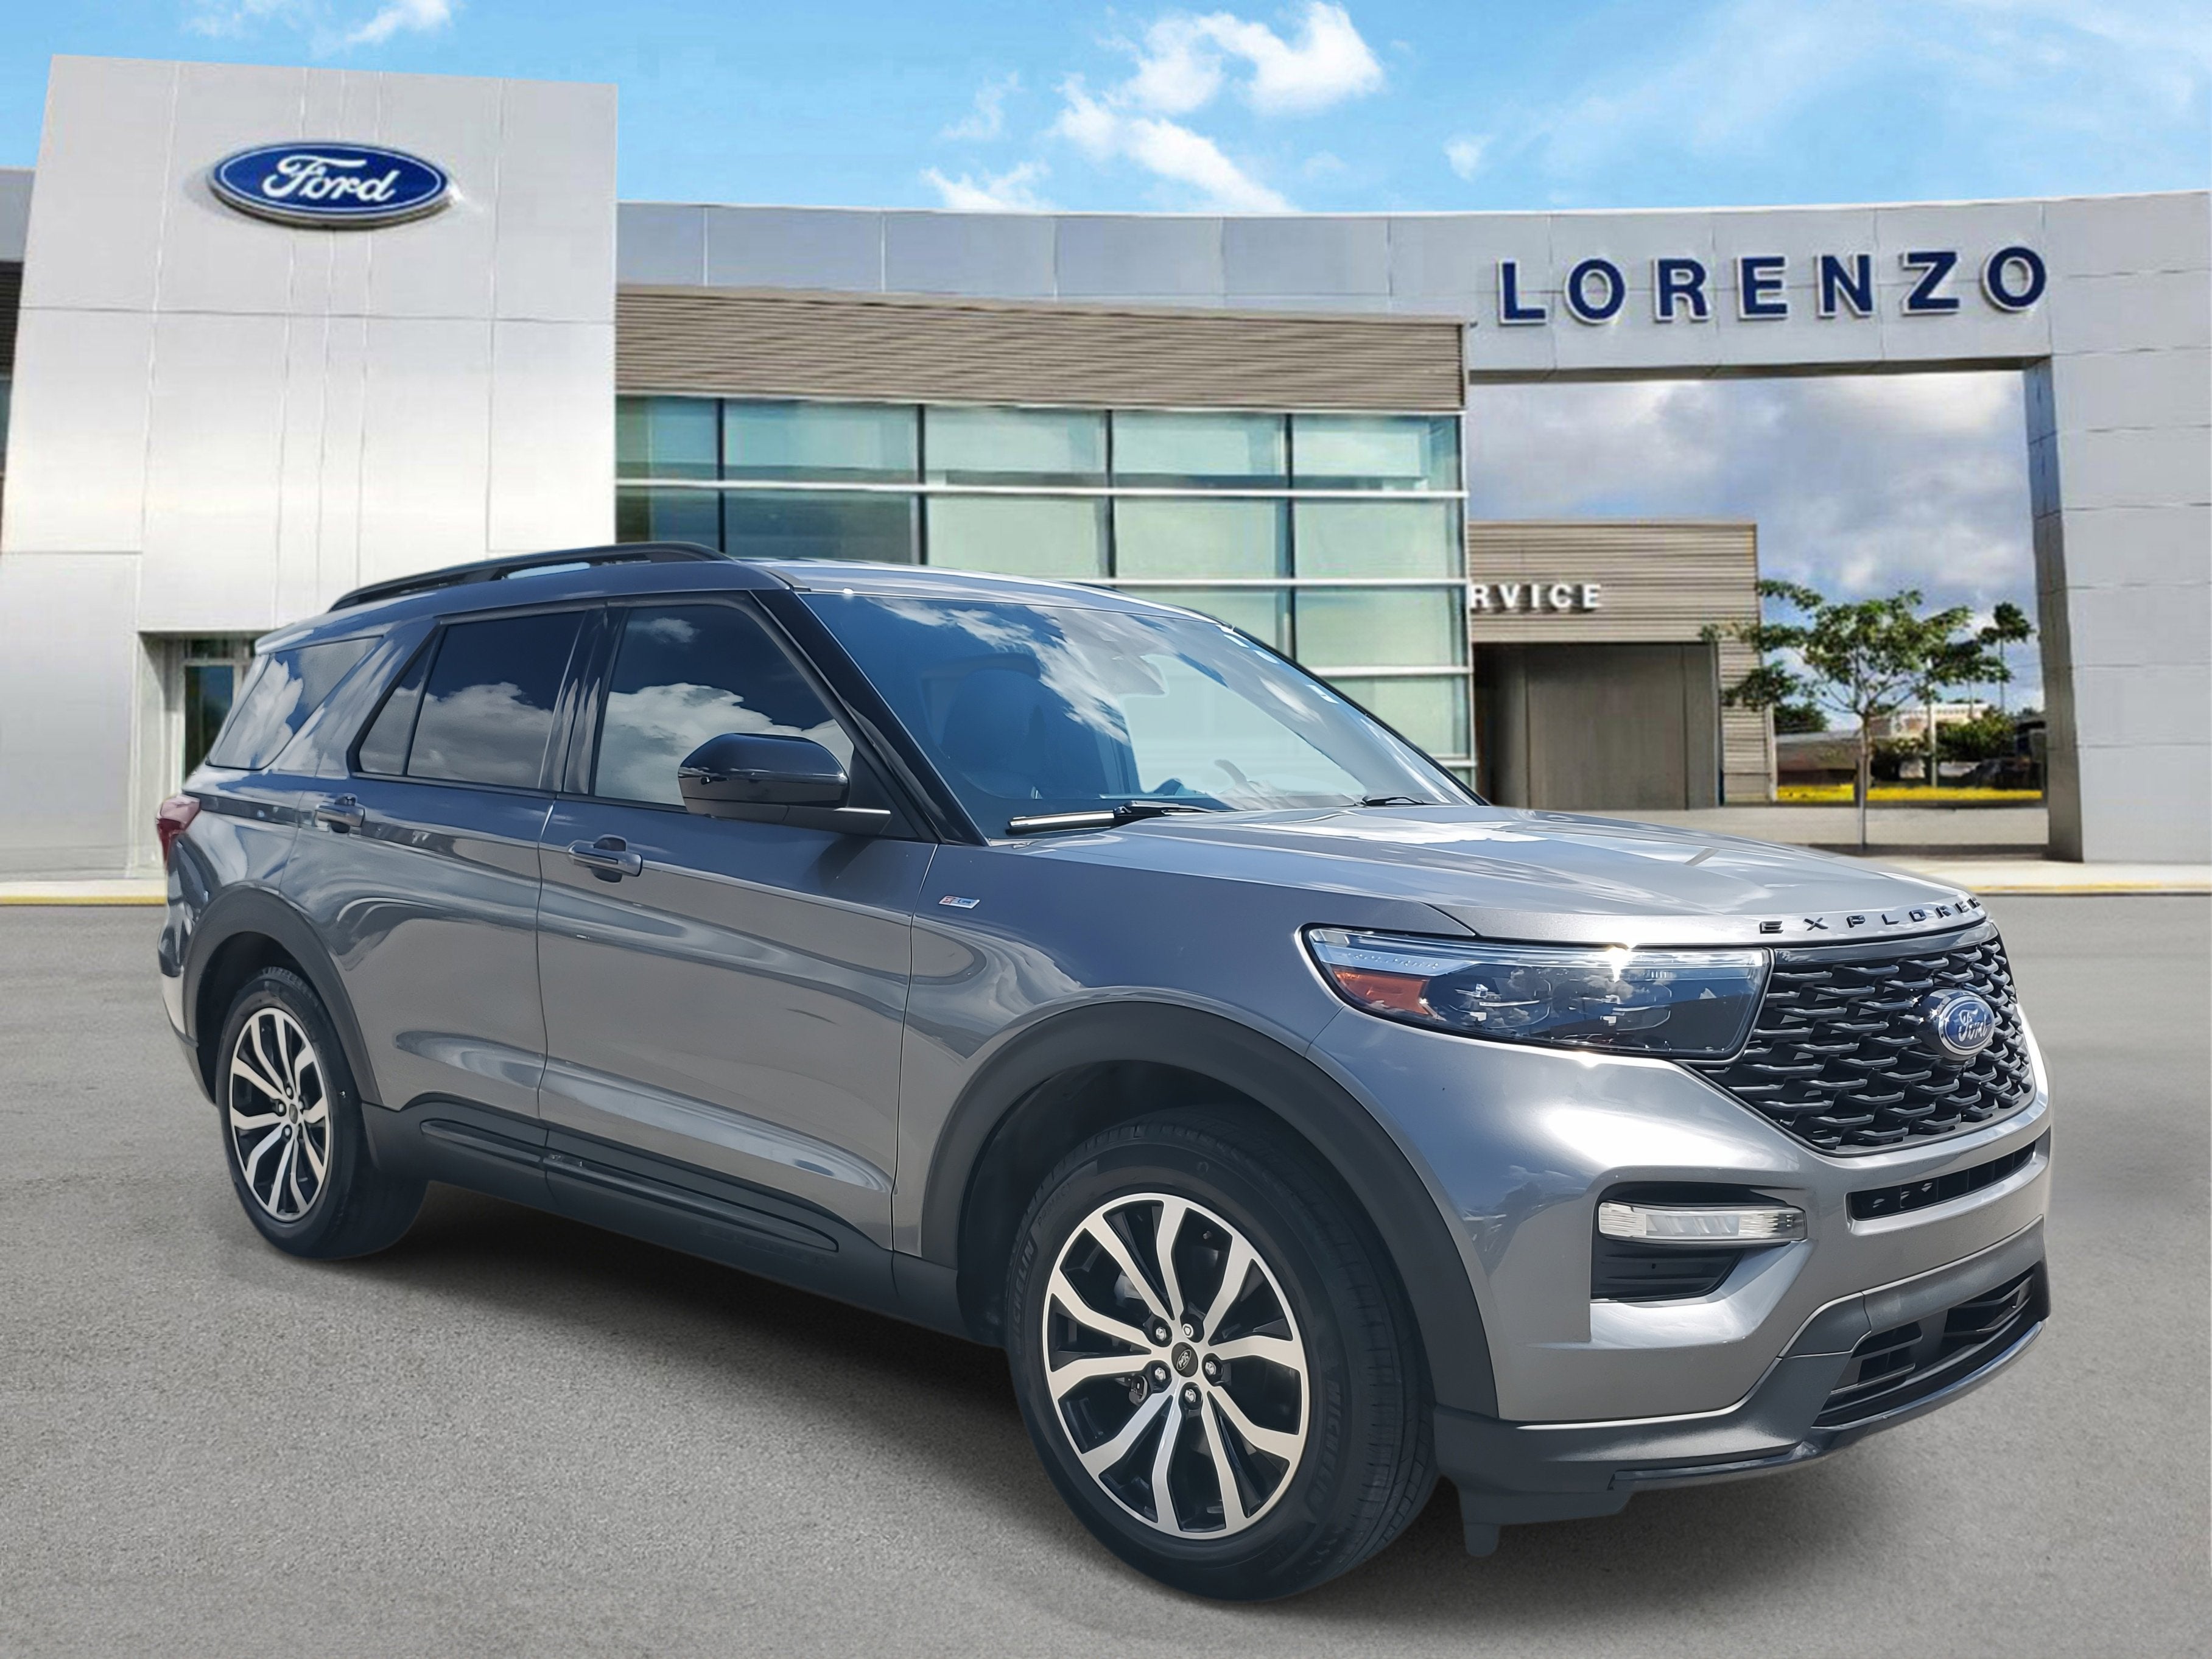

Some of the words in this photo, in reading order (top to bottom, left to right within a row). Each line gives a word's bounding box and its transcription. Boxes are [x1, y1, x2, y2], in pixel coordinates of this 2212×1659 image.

[262, 154, 401, 202] Ford
[1498, 245, 2048, 324] LORENZO
[1469, 583, 1603, 609] RVICE
[1758, 897, 1981, 935] EXPLORER
[1957, 1008, 1988, 1042] Ford
